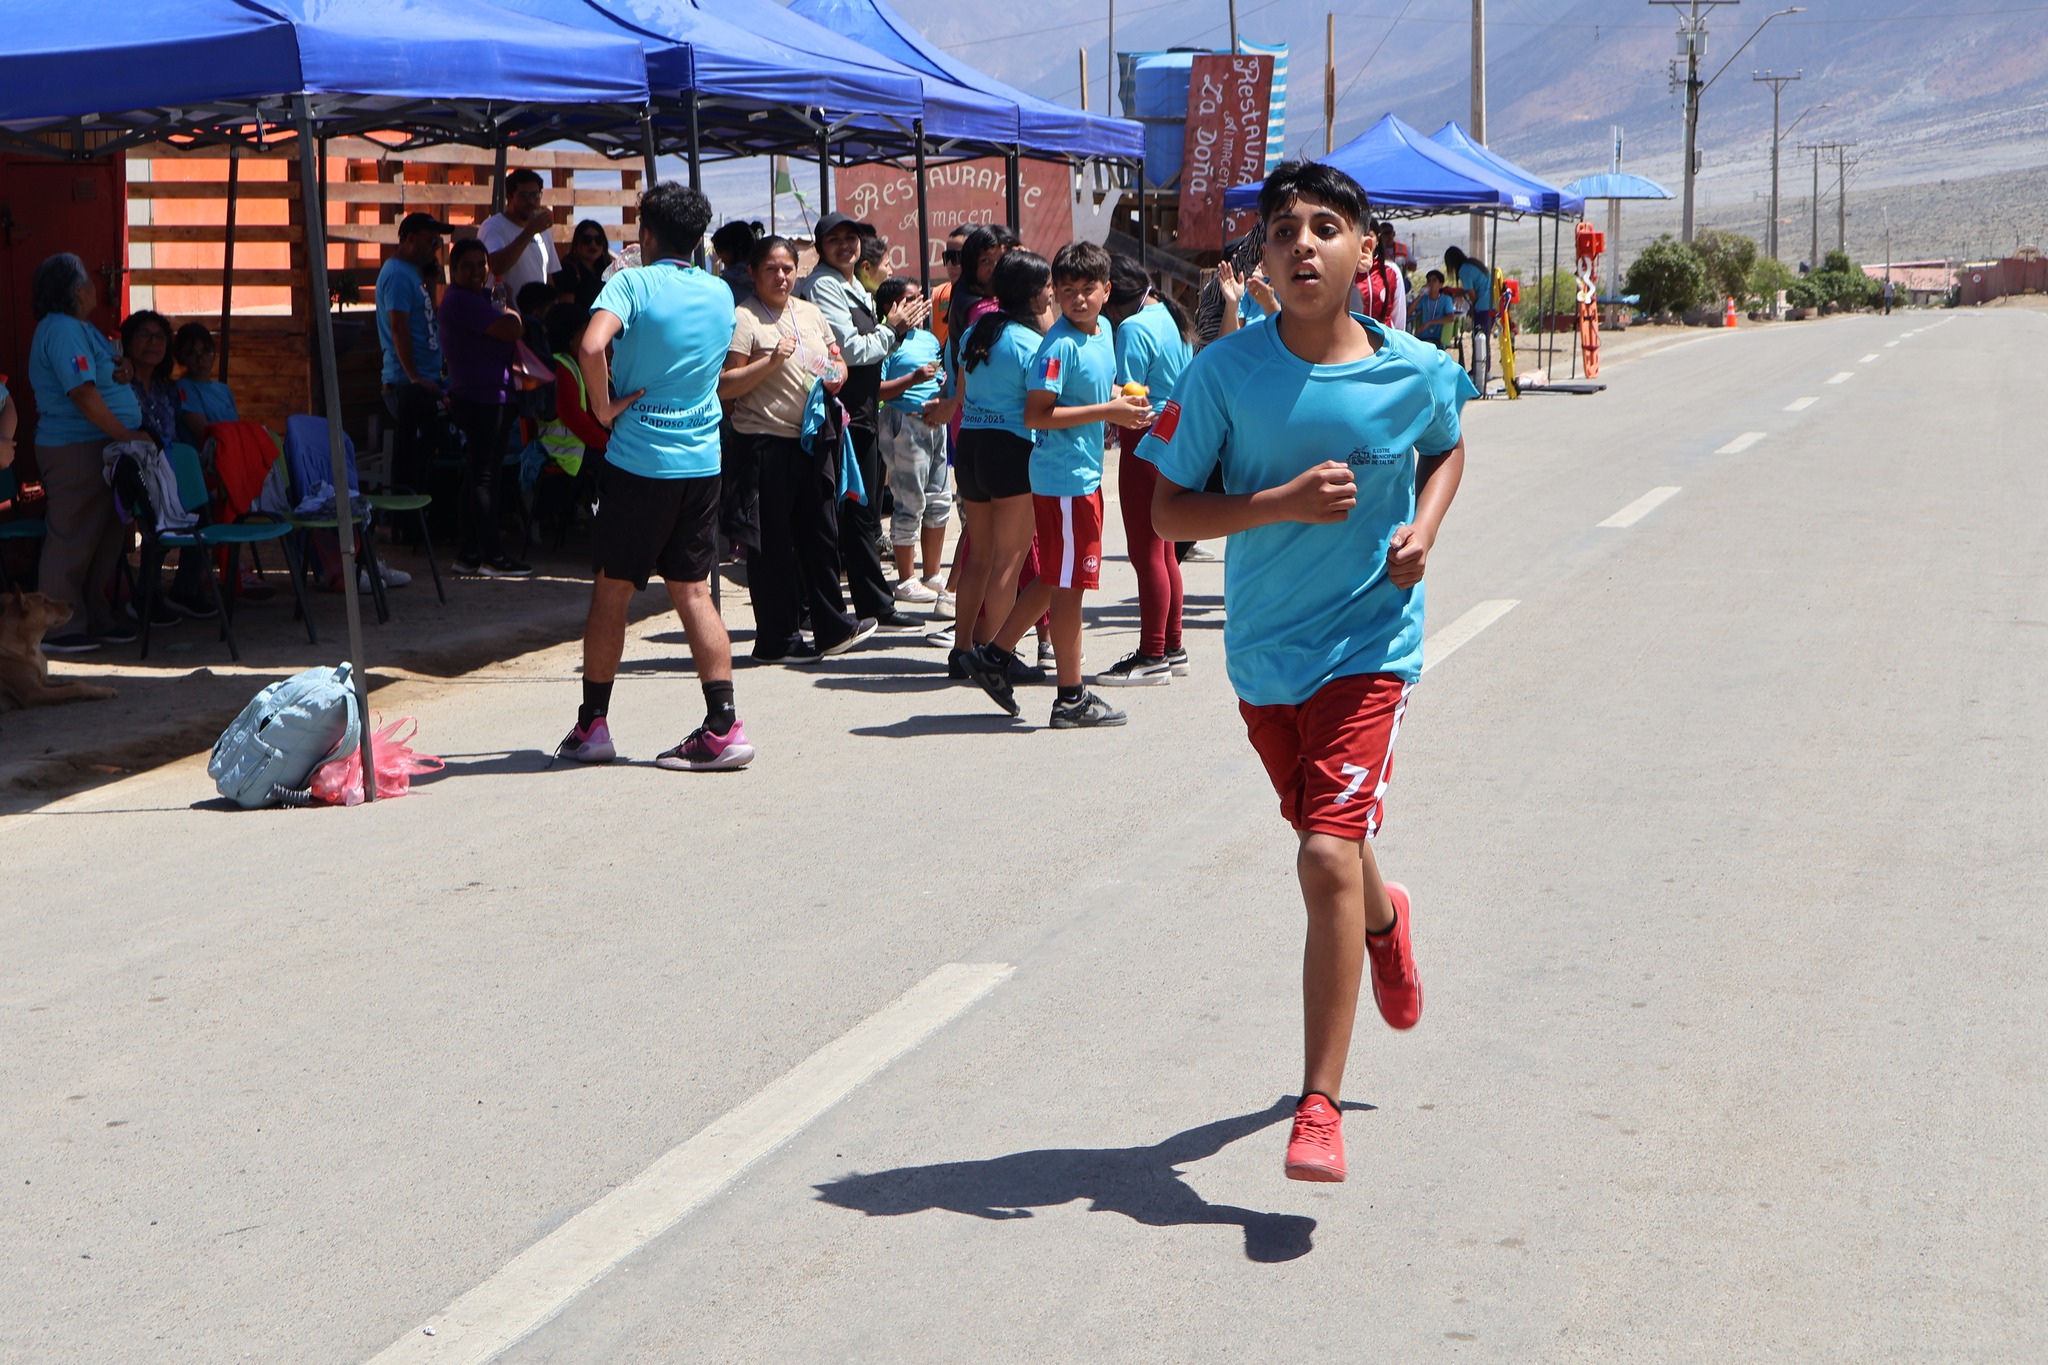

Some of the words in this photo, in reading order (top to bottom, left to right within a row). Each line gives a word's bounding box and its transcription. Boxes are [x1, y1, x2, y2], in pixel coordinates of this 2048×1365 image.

[640, 415, 684, 428] Paposo
[983, 414, 1005, 424] 2025
[1333, 762, 1370, 805] 7
